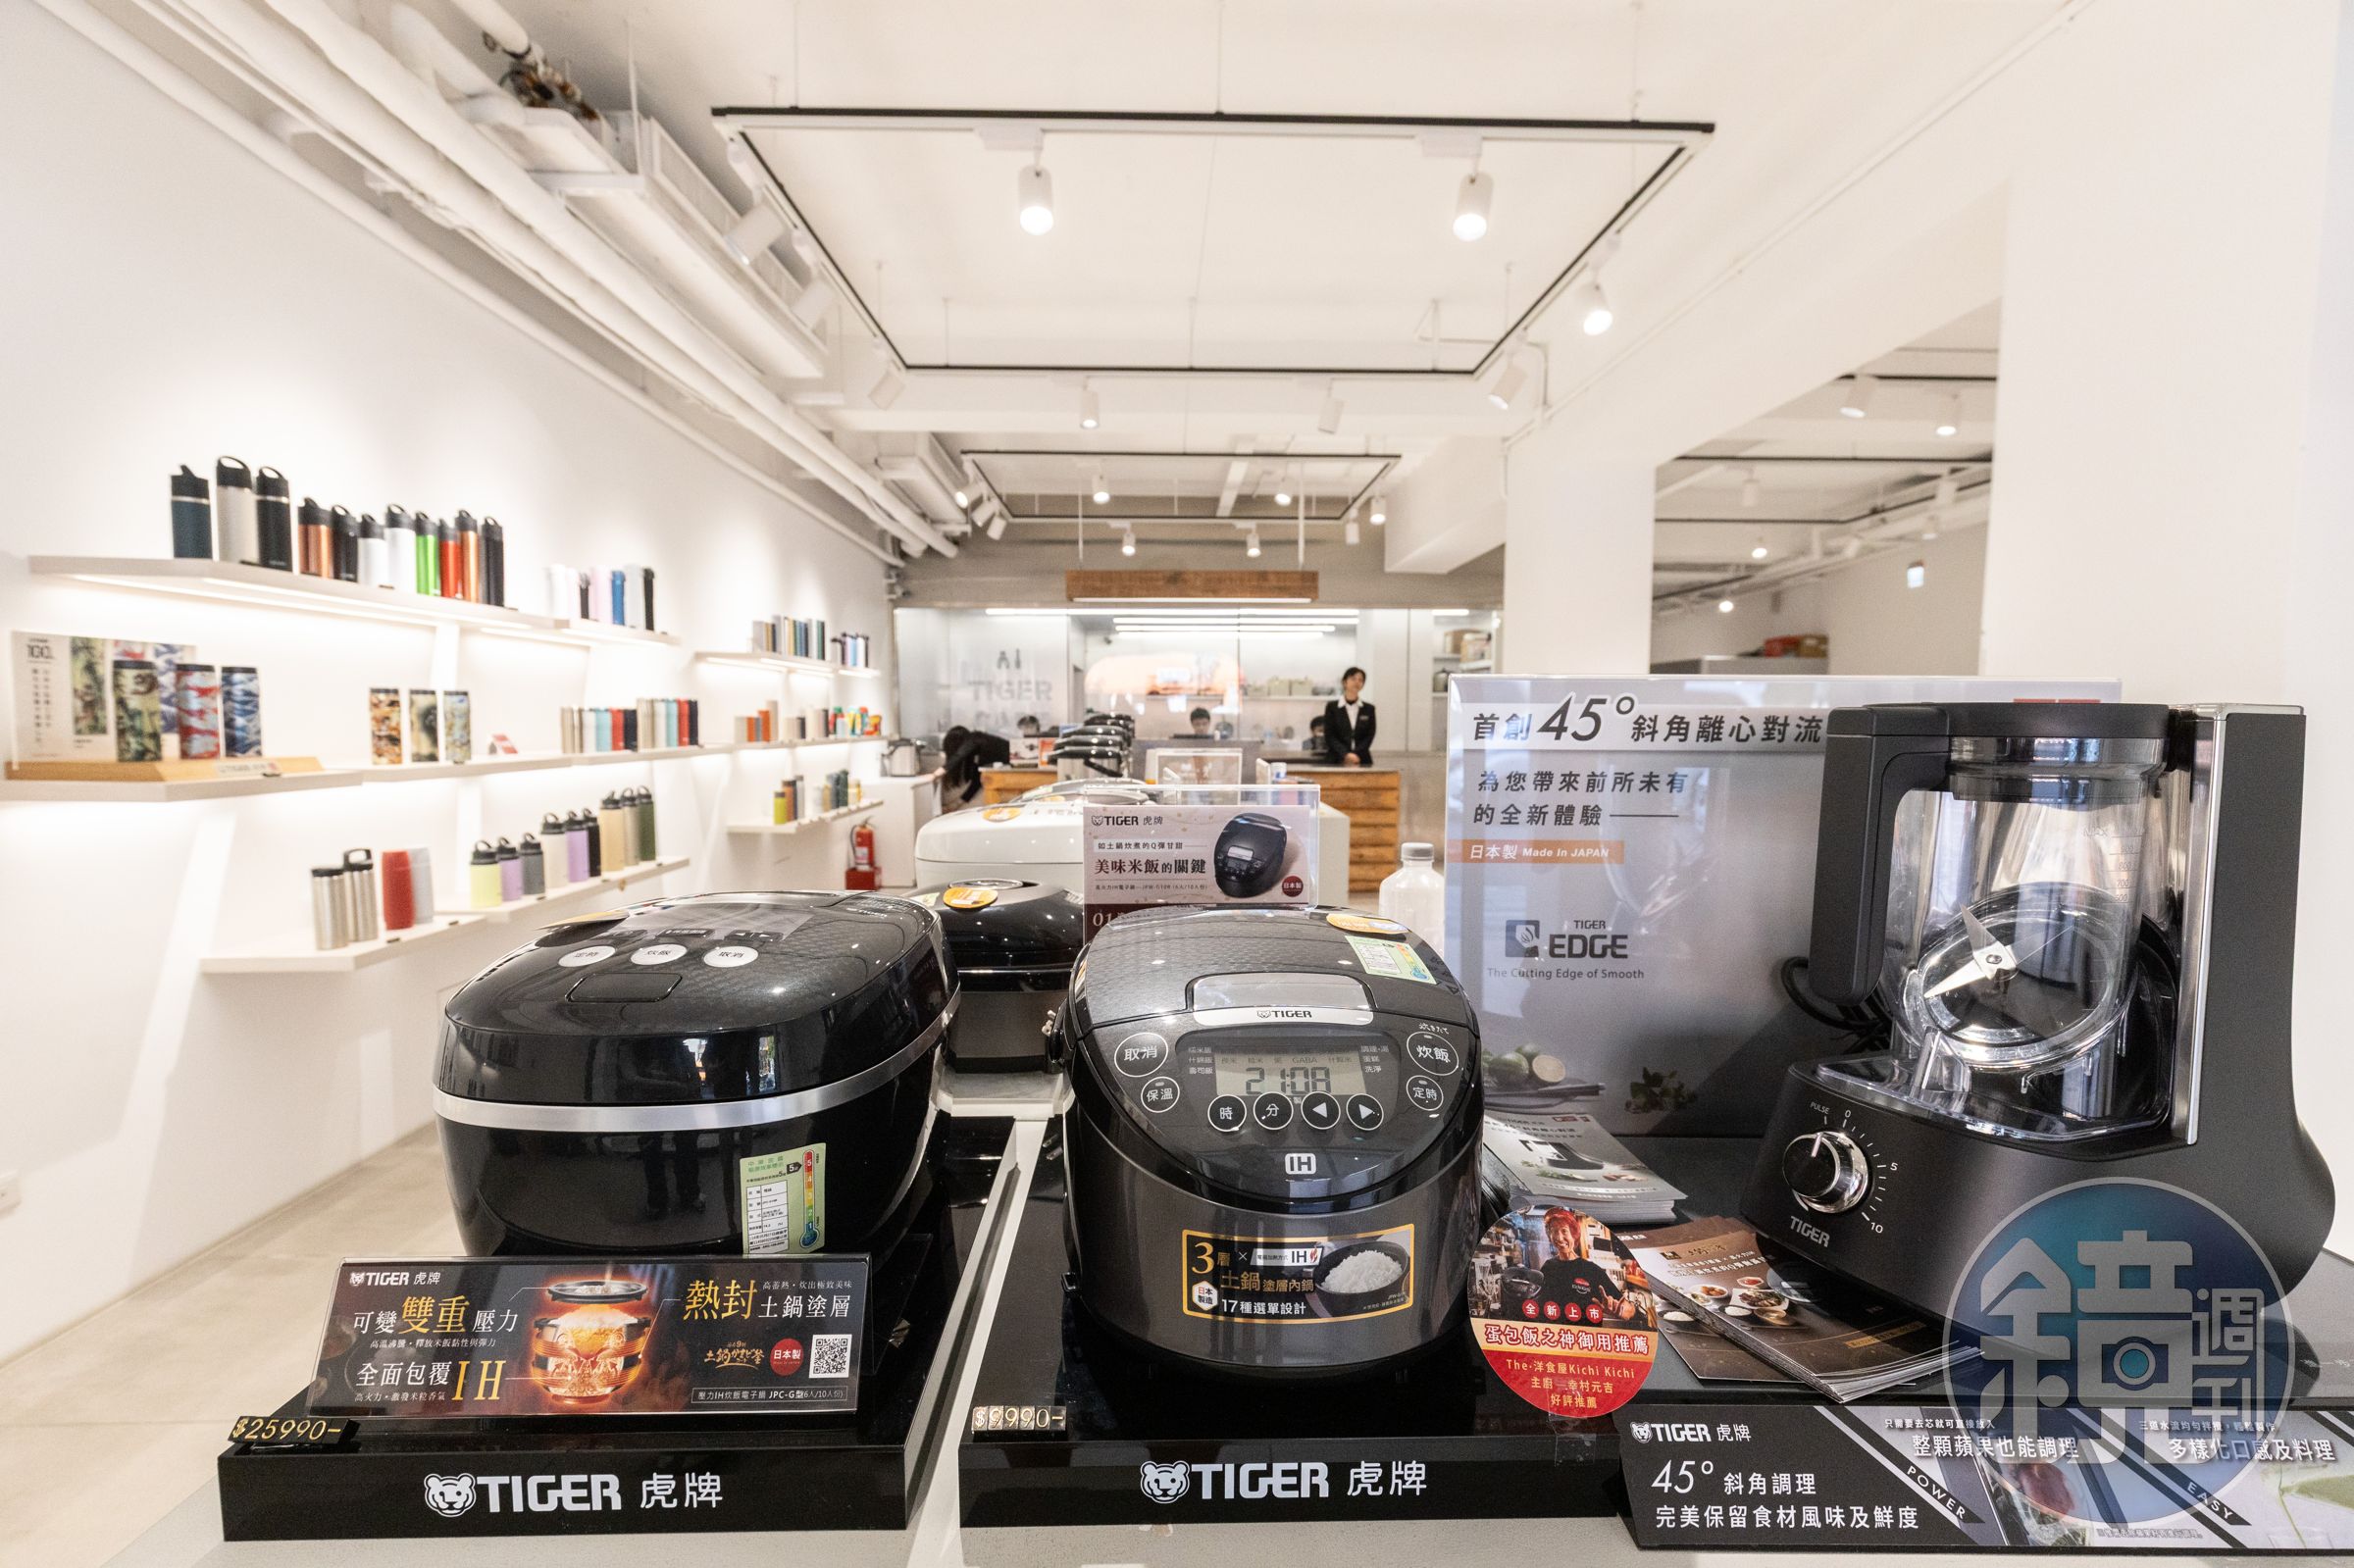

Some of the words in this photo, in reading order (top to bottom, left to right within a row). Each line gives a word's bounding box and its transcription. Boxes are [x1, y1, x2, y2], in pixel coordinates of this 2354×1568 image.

[1472, 691, 1823, 743] 首創45°斜角離心對流
[1478, 770, 1689, 793] 為您帶來前所未有
[1104, 816, 1139, 826] TIGER
[1143, 816, 1163, 826] 虎牌
[1473, 804, 1603, 827] 的全新體驗
[1470, 844, 1517, 861] 日本製
[1522, 848, 1554, 858] Made
[1558, 848, 1567, 858] In
[1570, 848, 1610, 858] JAPAN
[1095, 859, 1206, 875] 美味米飯的關鍵
[1573, 920, 1607, 930] TIGER
[1549, 934, 1629, 960] EDGE
[1487, 968, 1509, 979] The
[1511, 968, 1554, 982] Cutting
[1557, 969, 1585, 981] Edge
[1587, 968, 1599, 979] of
[1602, 969, 1645, 979] Smooth
[1274, 1009, 1312, 1019] TIGER
[1123, 1044, 1158, 1062] 取消
[1415, 1045, 1451, 1064] 炊飯
[1146, 1087, 1173, 1102] 保溫
[1412, 1087, 1438, 1101] 定時
[1219, 1106, 1233, 1120] 時
[1265, 1103, 1280, 1117] 分
[1810, 1101, 1830, 1115] PULSE
[1290, 1156, 1312, 1172] IH
[1890, 1162, 1899, 1171] 5
[1790, 1215, 1831, 1248] TIGER
[1870, 1222, 1884, 1234] 10
[1191, 1241, 1231, 1274] 3層
[1291, 1250, 1307, 1263] IH
[367, 1272, 409, 1286] TIGER
[413, 1272, 441, 1286] 虎牌
[1220, 1270, 1314, 1292] 土鍋塗層內鍋
[1198, 1286, 1213, 1295] 日本
[353, 1294, 519, 1335] 可變雙重壓力
[1221, 1298, 1306, 1315] 17種選單設計
[1525, 1303, 1601, 1319] 全新上市
[1485, 1324, 1649, 1355] 蛋包飯之神御用推薦
[773, 1349, 801, 1360] 日本製
[355, 1360, 507, 1401] 全面包覆IH
[1605, 1366, 1635, 1379] Kichi
[1531, 1376, 1554, 1390] 主廚
[1567, 1379, 1614, 1394] 幸村元吉
[1550, 1394, 1598, 1409] 好評推薦
[1652, 1424, 1712, 1442] TIGER
[1716, 1423, 1752, 1442] 虎牌
[1912, 1435, 2079, 1458] 整顆蘋果也能調理
[2169, 1438, 2337, 1461] 多樣化口感及料理
[1191, 1463, 1329, 1500] TIGER
[1347, 1460, 1427, 1496] 虎牌
[1651, 1459, 1714, 1494] 45°
[1723, 1472, 1817, 1495] 斜角調理
[477, 1474, 622, 1512] TIGER
[640, 1472, 724, 1511] 虎牌
[1906, 1465, 1967, 1520] POWER
[2186, 1481, 2234, 1520] EASY
[1655, 1505, 1919, 1530] 完美保留食材風味及鮮度
